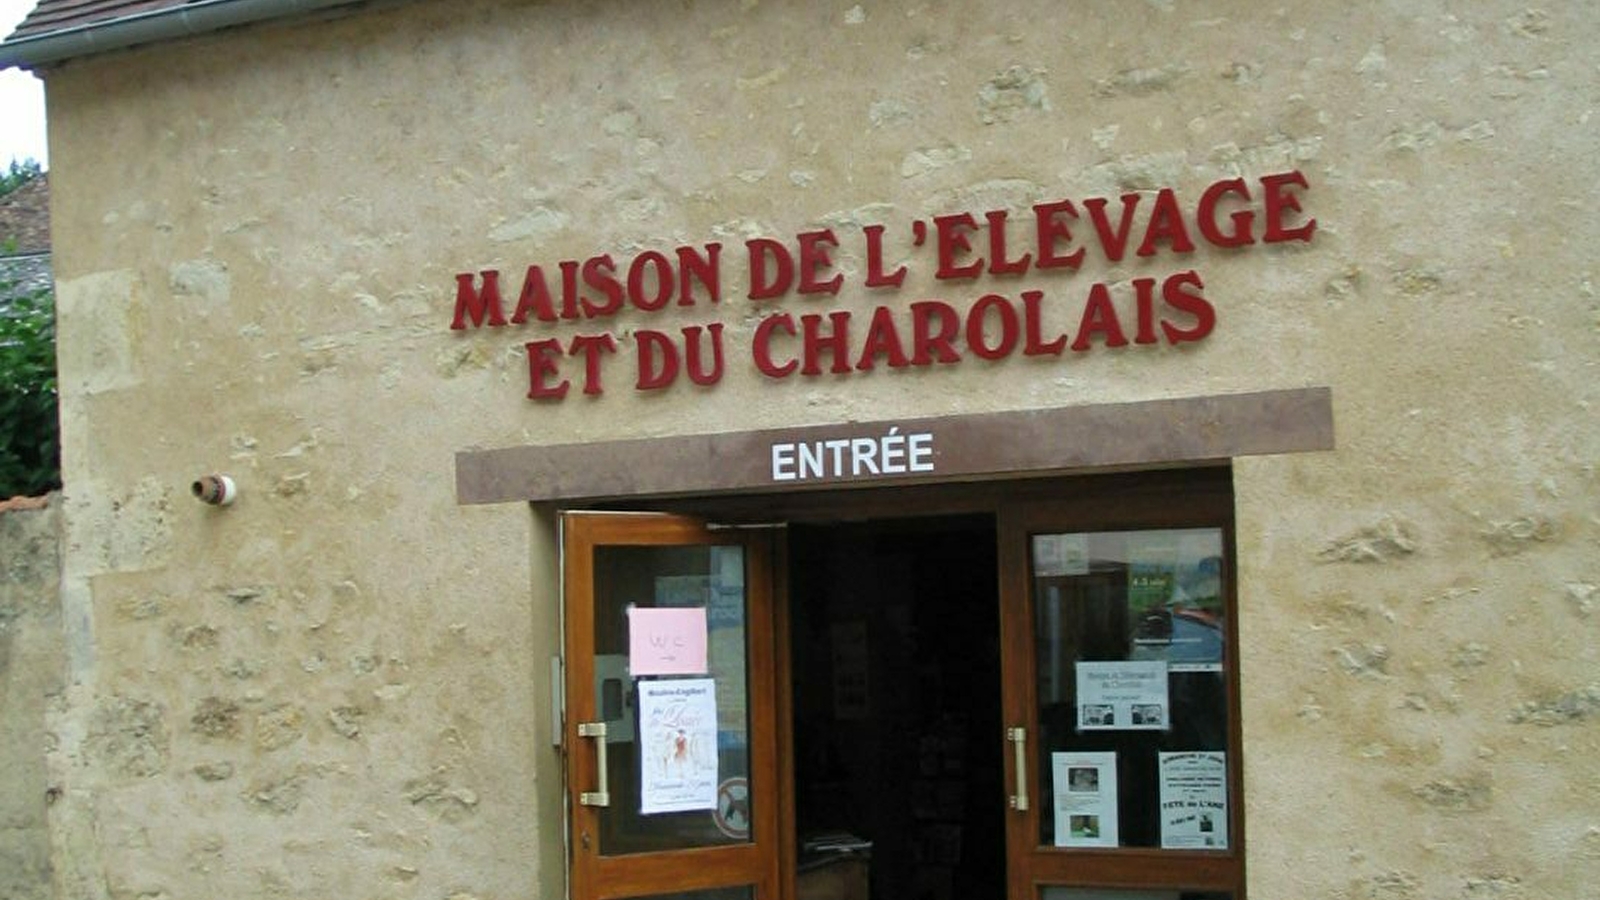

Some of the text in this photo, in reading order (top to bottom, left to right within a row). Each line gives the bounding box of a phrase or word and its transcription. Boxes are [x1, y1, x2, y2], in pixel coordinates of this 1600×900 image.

[451, 172, 1316, 330] MAISON DE L'ELEVAGE
[527, 270, 1216, 398] ET DU CHAROLAIS
[772, 427, 935, 481] ENTRÉE
